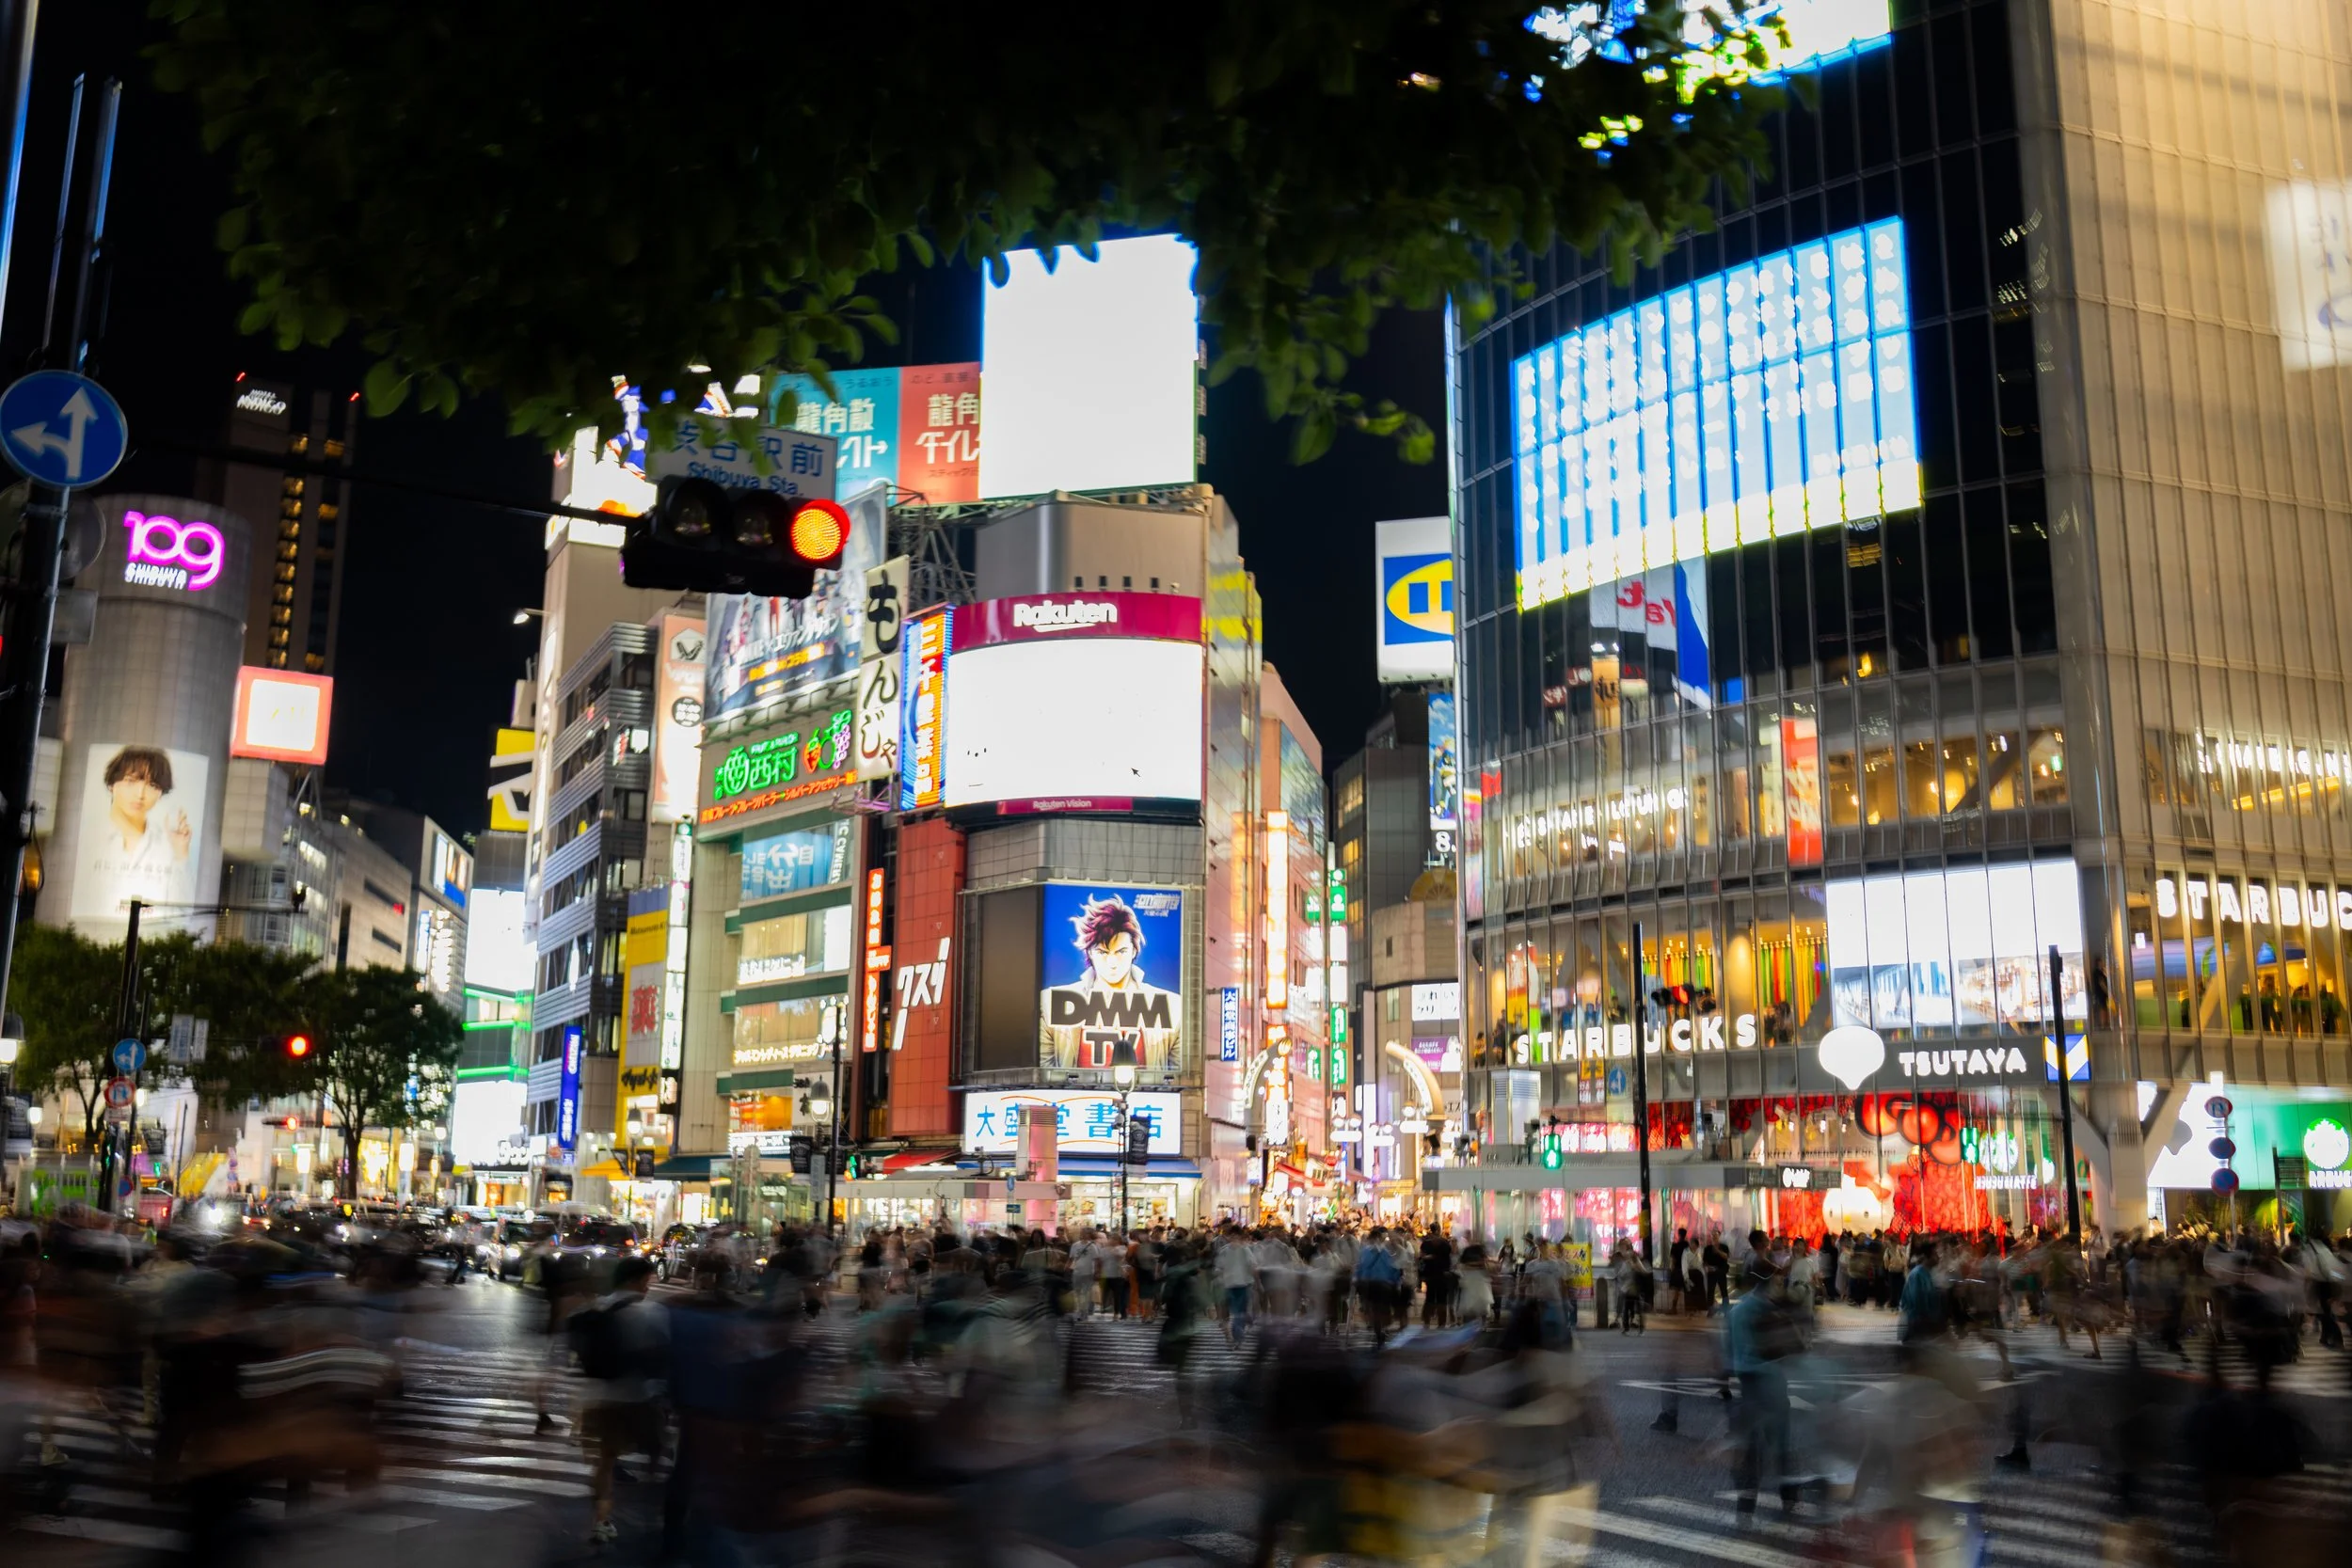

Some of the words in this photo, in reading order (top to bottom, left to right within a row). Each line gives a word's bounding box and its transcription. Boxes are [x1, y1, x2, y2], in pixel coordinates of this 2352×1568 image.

[687, 461, 761, 489] Shibuya
[124, 511, 224, 591] 109
[124, 562, 187, 590] SHIBUYA
[1013, 599, 1118, 628] Rakuten
[1066, 798, 1092, 808] Vision
[1051, 990, 1172, 1029] DMM
[1517, 1014, 1757, 1065] STARBUCKS
[1899, 1047, 2027, 1077] TSUTAYA
